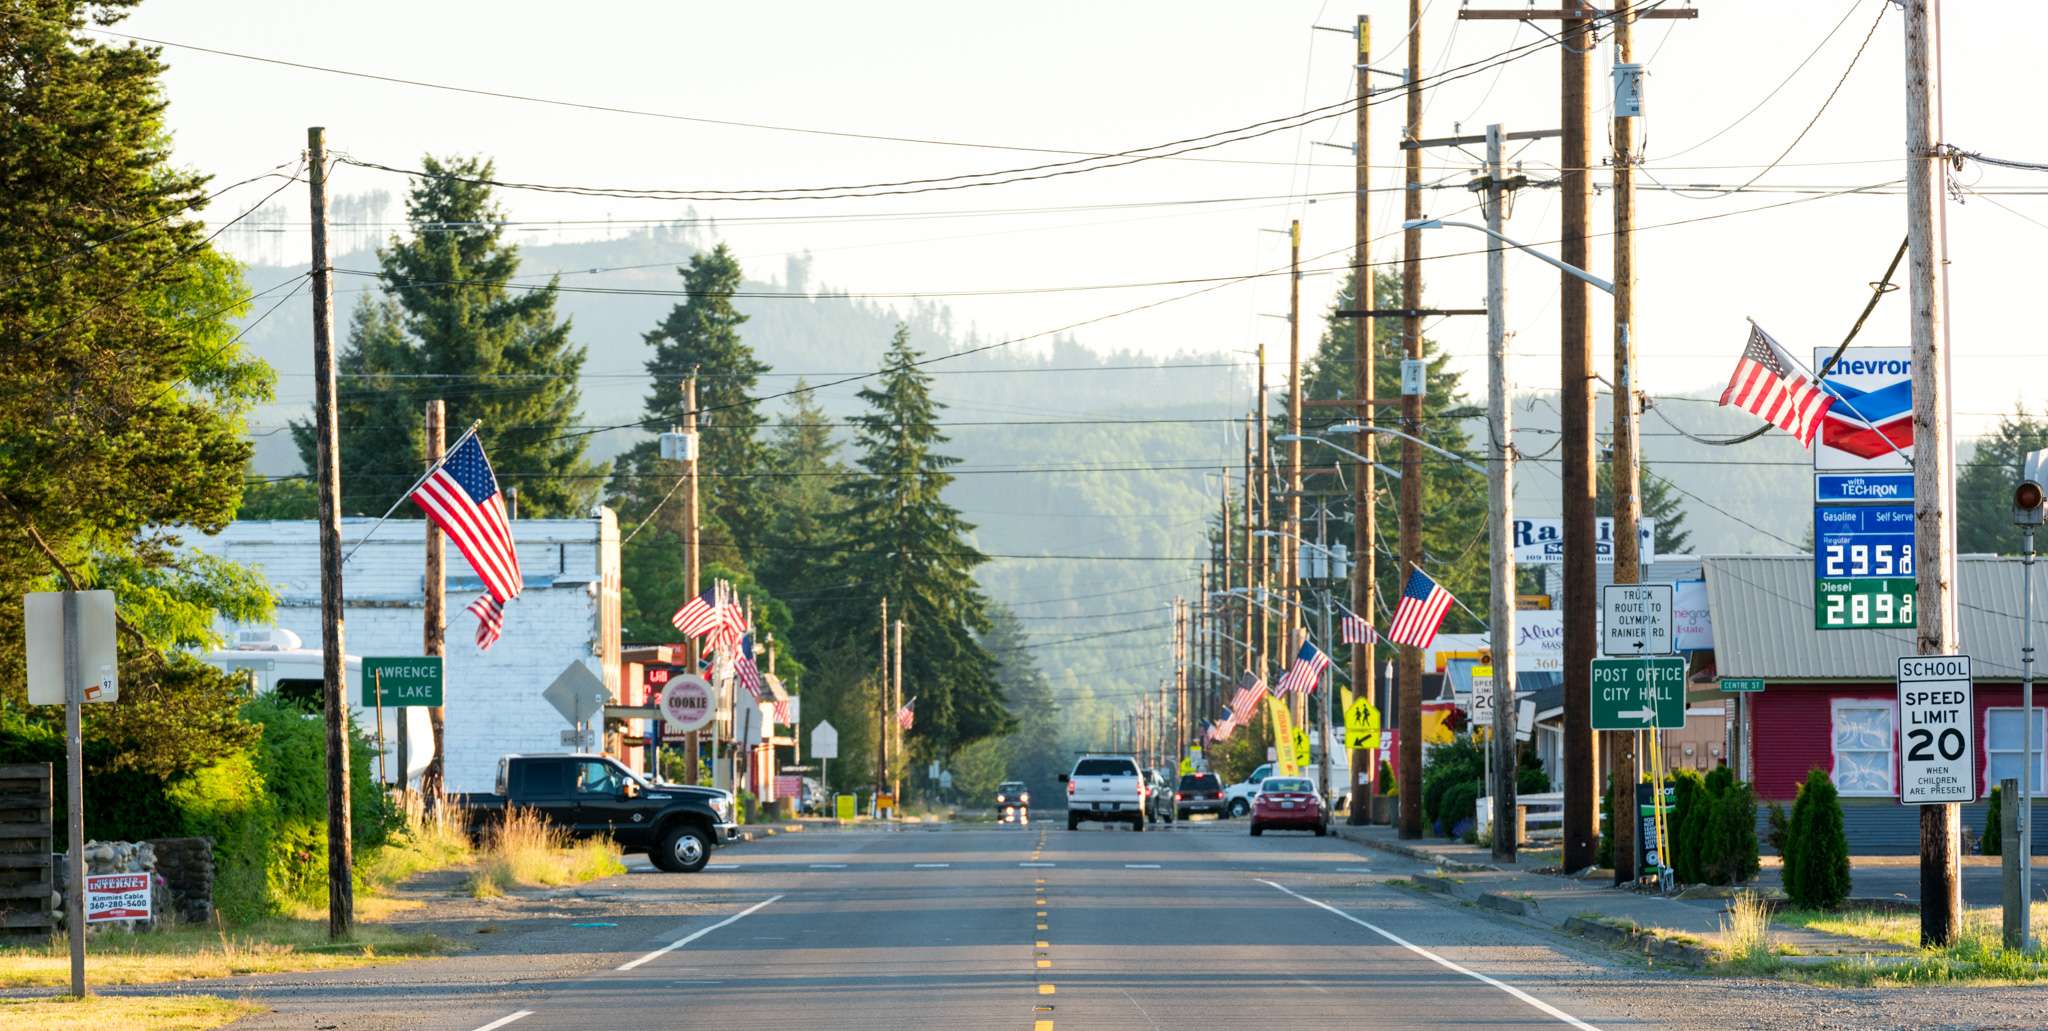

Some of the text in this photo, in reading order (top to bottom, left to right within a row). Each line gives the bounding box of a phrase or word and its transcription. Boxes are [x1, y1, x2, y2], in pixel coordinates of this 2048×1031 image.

[1841, 484, 1897, 497] TECHRON
[1823, 512, 1857, 522] Gasoline
[1876, 511, 1913, 521] Self Serve
[1821, 582, 1852, 592] Diesel
[1624, 590, 1653, 600] TRUCK
[1615, 603, 1662, 612] ROUTE TO
[1611, 628, 1664, 637] RAINIER RD
[367, 667, 437, 678] LAWRENCE
[1594, 667, 1681, 682] POST OFFICE
[1903, 662, 1967, 676] SCHOOL
[1724, 681, 1760, 689] CENTRE ST
[398, 686, 433, 698] LAKE
[1603, 687, 1672, 701] CITY HALL
[669, 697, 708, 709] COOKIE
[1905, 691, 1965, 706] SPEED
[1911, 710, 1959, 724] LIMIT
[1907, 727, 1966, 762] 20
[1918, 777, 1957, 785] CHILDREN
[1931, 786, 1966, 794] PRESENT
[90, 880, 145, 890] INTERNET
[90, 899, 147, 910] 360-280-5400
